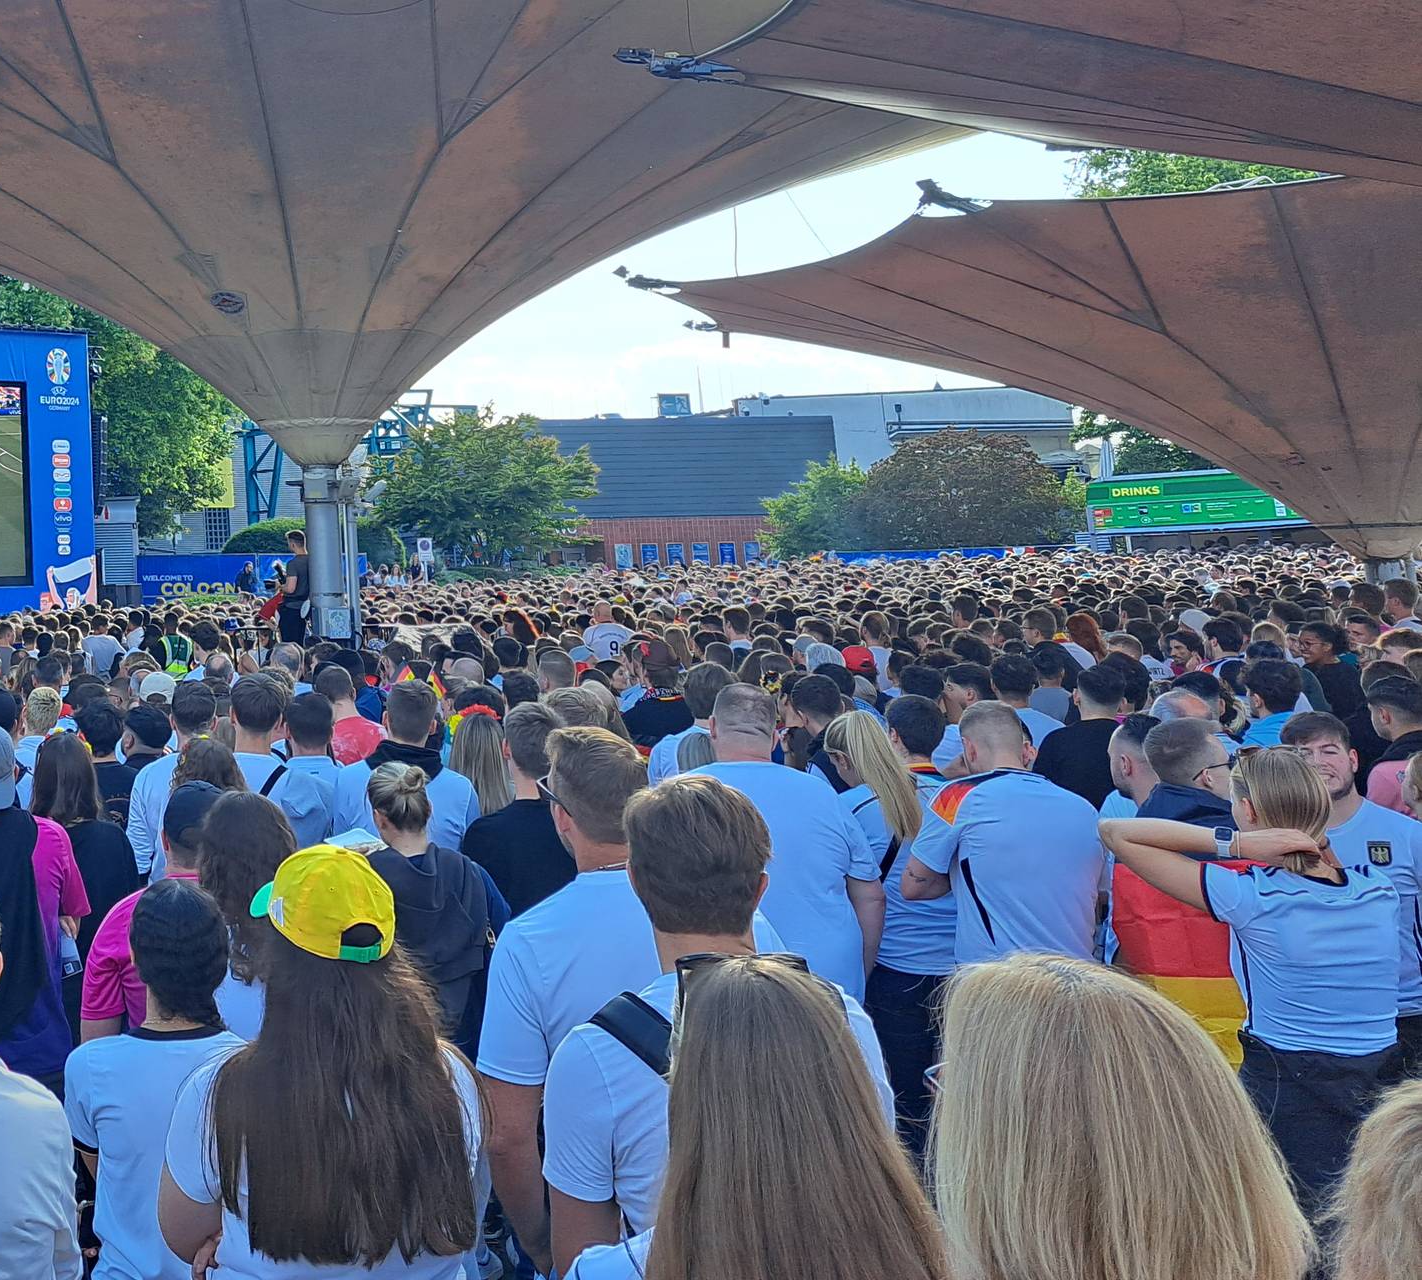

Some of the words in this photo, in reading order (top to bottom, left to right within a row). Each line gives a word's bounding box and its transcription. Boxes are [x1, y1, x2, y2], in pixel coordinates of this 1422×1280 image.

[1111, 486, 1161, 497] DRINKS
[161, 582, 236, 596] COLOGN
[609, 640, 619, 656] 9
